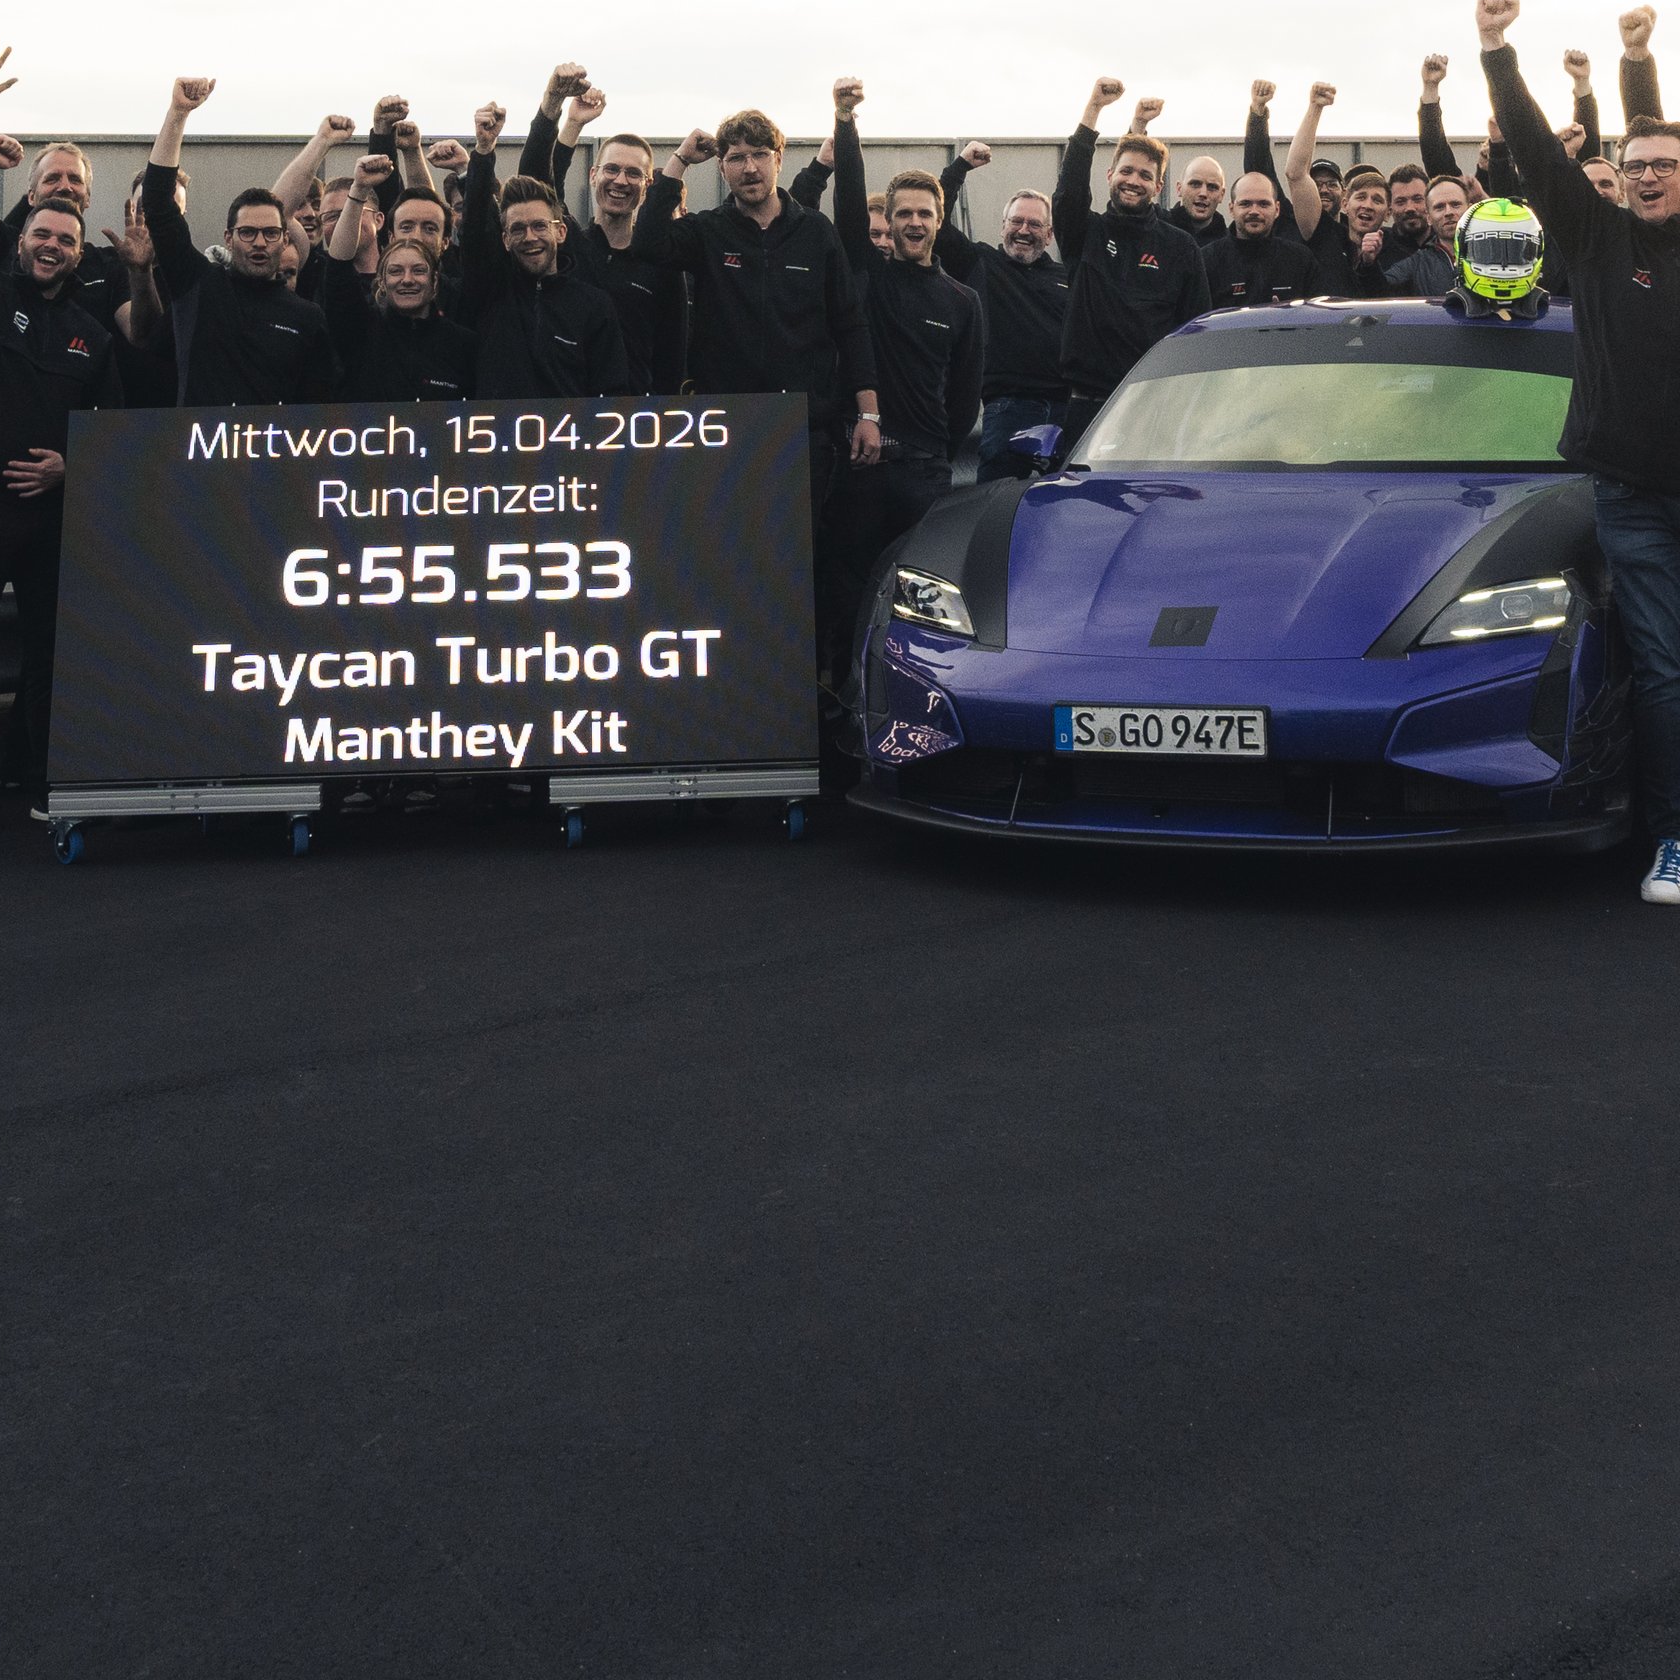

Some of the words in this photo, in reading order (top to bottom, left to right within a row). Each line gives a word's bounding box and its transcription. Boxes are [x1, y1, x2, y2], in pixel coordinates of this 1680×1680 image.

[188, 414, 427, 460] Mittwoch,
[445, 409, 729, 453] 15.04.2026
[317, 475, 598, 519] Rundenzeit:
[282, 541, 632, 607] 6:55.533
[192, 643, 416, 706] Taycan
[435, 631, 620, 684] Turbo
[640, 629, 722, 678] GT
[283, 711, 534, 769] Manthey
[552, 709, 628, 755] Kit
[1060, 732, 1068, 744] D
[1074, 712, 1096, 746] S
[1120, 713, 1164, 748] GO
[1171, 715, 1261, 751] 947E
